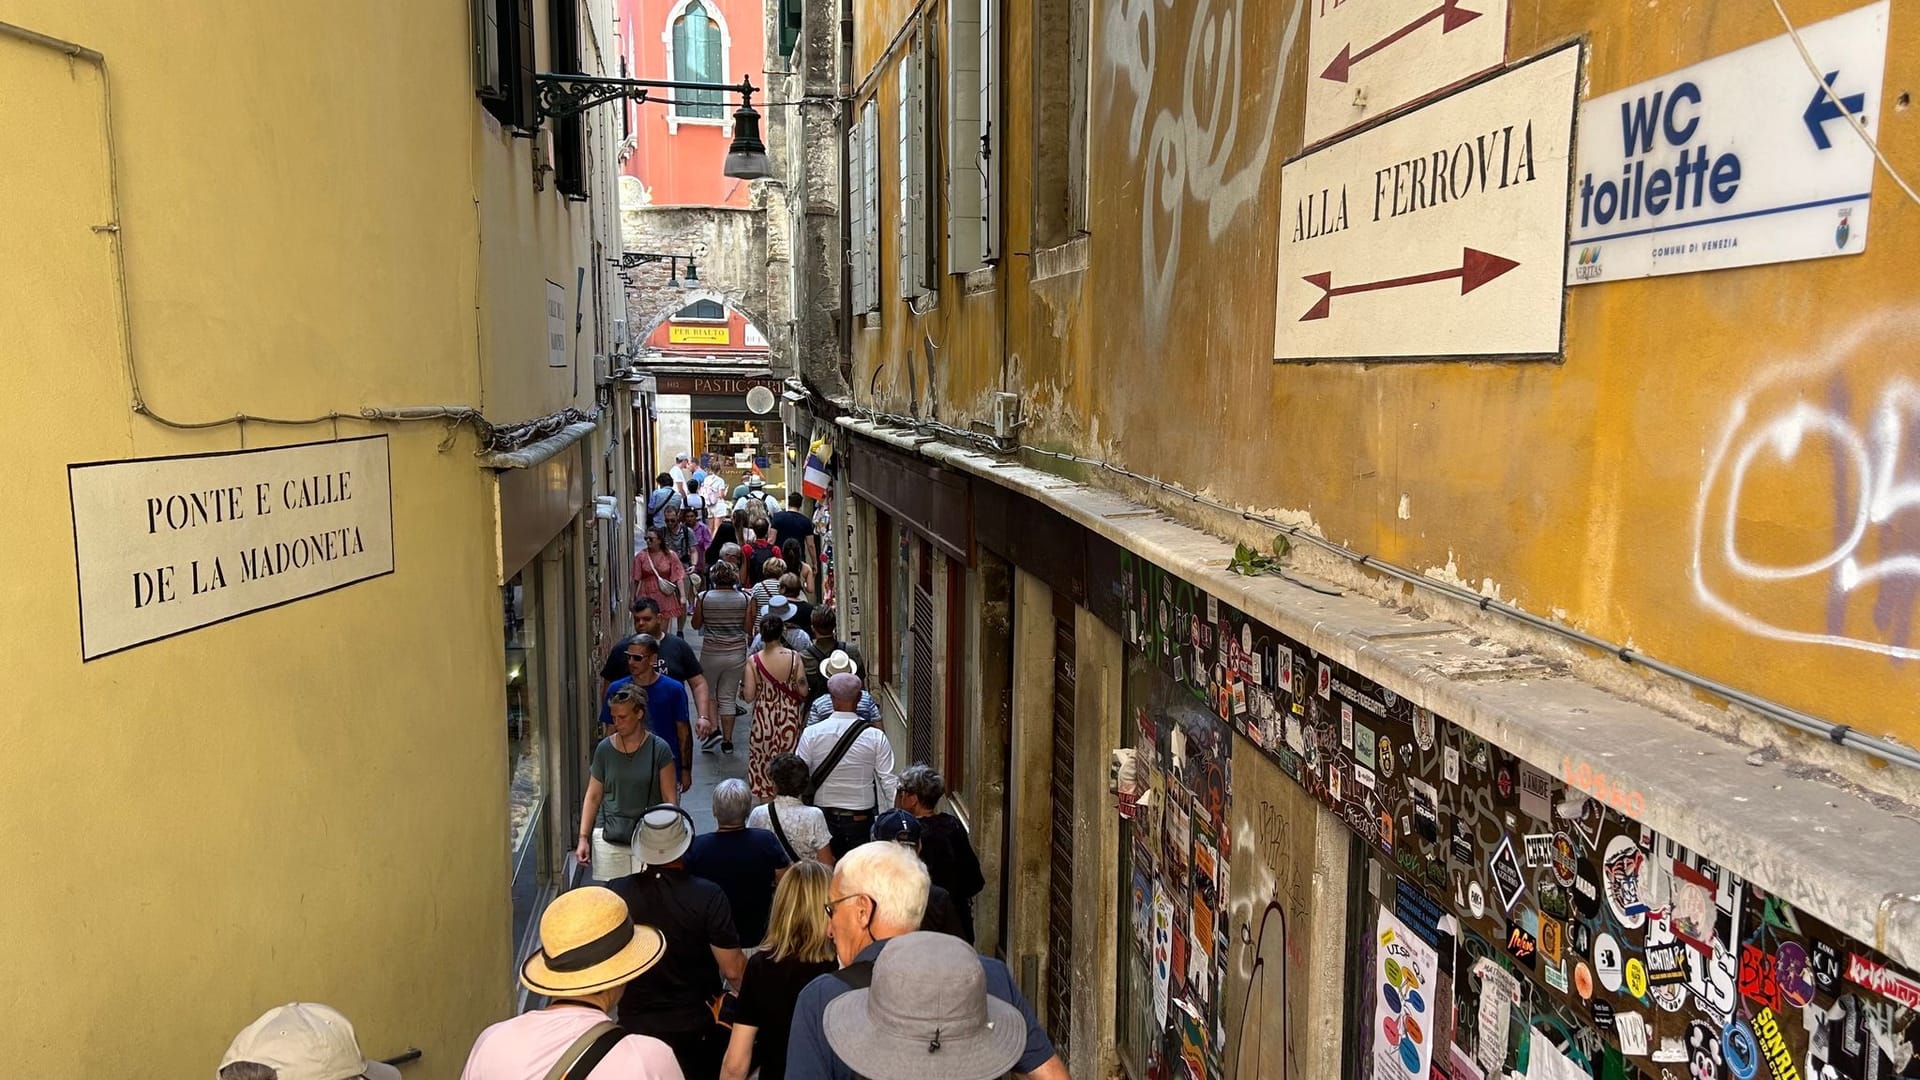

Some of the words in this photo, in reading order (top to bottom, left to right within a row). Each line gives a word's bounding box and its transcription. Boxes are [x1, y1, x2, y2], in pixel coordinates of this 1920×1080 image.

[1620, 81, 1702, 158] WC
[1292, 183, 1349, 243] ALLA
[1372, 118, 1537, 223] FERROVIA
[1580, 144, 1741, 228] toilette
[1652, 243, 1686, 258] COMUNE
[1689, 241, 1699, 254] DI
[1701, 237, 1739, 252] VENEZIA
[673, 328, 690, 336] PER
[693, 328, 725, 336] RIALTO
[147, 486, 244, 534] PONTE
[256, 483, 271, 515] E
[283, 471, 352, 510] CALLE
[132, 566, 176, 609] DE
[191, 556, 227, 595] LA
[240, 526, 365, 583] MADONETA
[1757, 1006, 1801, 1080] SONRI
